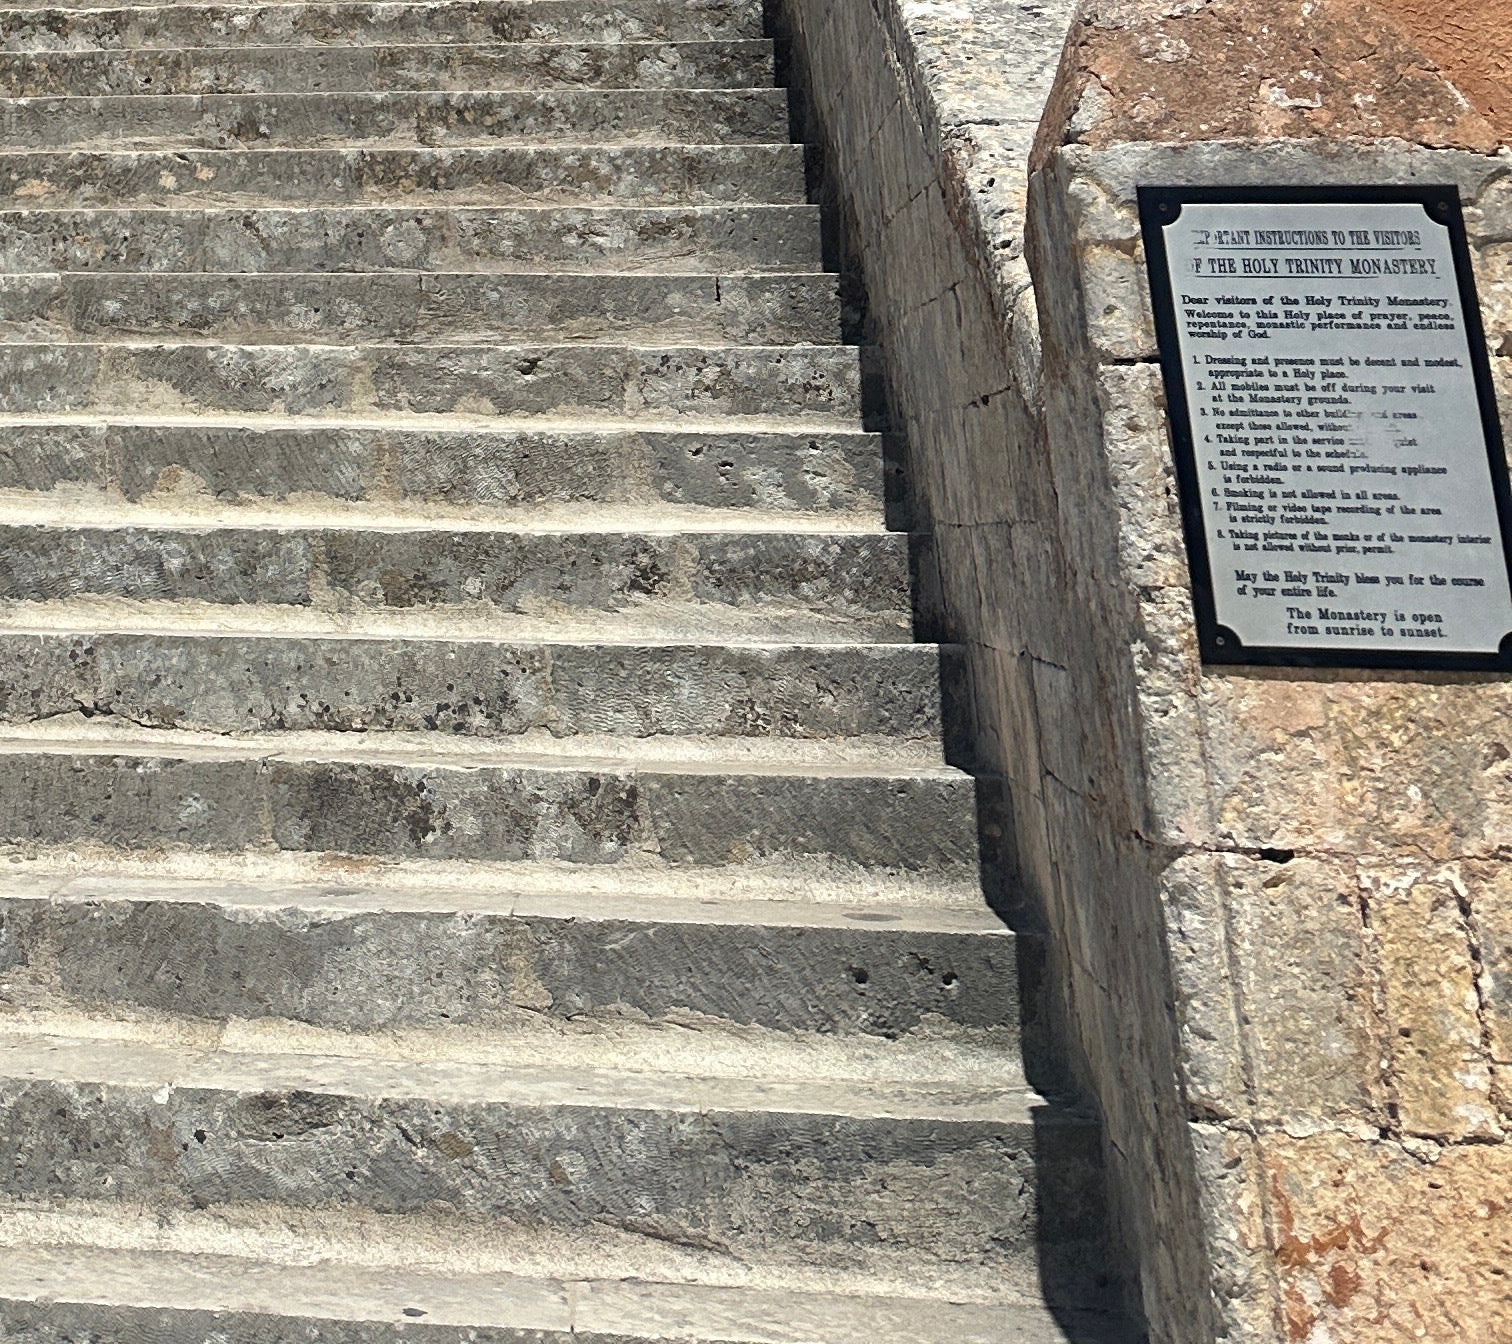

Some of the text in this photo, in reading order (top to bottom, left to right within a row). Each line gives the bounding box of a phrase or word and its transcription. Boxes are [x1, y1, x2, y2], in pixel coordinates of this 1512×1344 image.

[1254, 230, 1328, 245] INSTRUCTIONS
[1332, 231, 1345, 245] TO
[1349, 231, 1370, 245] THE
[1374, 231, 1421, 245] VISITORS
[1186, 258, 1436, 274] F THE HOLY TRINITY MONASTERY
[1181, 295, 1209, 305] Dear
[1215, 296, 1257, 305] visitors
[1263, 296, 1274, 305] of
[1280, 296, 1299, 305] the
[1305, 296, 1332, 307] Holy
[1338, 296, 1380, 307] Trinity
[1184, 310, 1233, 318] Welcome
[1239, 310, 1250, 318] to
[1256, 310, 1278, 318] this
[1283, 310, 1310, 321] Holy
[1316, 311, 1346, 321] place
[1352, 311, 1362, 320] of
[1255, 321, 1305, 329] monastic
[1311, 321, 1381, 331] performance
[1414, 321, 1454, 329] endless
[1188, 330, 1271, 340] worship of God.
[1193, 355, 1200, 365] 1.
[1205, 355, 1247, 367] Dressing
[1251, 356, 1270, 365] and
[1274, 357, 1315, 366] presence
[1320, 357, 1344, 365] must
[1349, 357, 1360, 366] be
[1365, 357, 1396, 366] decent
[1401, 357, 1420, 366] and
[1209, 369, 1264, 379] appropriate
[1268, 369, 1278, 377] to
[1293, 369, 1315, 380] Holy
[1197, 382, 1436, 395] 2. All mobiles must be off during your visit
[1228, 394, 1244, 402] the
[1249, 394, 1302, 405] Monastery
[1213, 408, 1225, 416] No
[1230, 408, 1279, 417] admittance
[1283, 409, 1292, 417] to
[1296, 409, 1319, 417] other
[1216, 422, 1244, 431] except
[1248, 422, 1272, 430] those
[1217, 435, 1249, 445] Taking
[1254, 436, 1274, 444] part
[1278, 436, 1288, 444] in
[1292, 436, 1307, 444] the
[1312, 436, 1345, 445] service
[1220, 448, 1236, 456] and
[1242, 448, 1288, 459] respectful
[1292, 449, 1302, 457] to
[1306, 449, 1321, 458] the
[1208, 462, 1216, 470] 5.
[1220, 462, 1248, 472] Using
[1264, 463, 1287, 471] radio
[1317, 463, 1345, 472] sound
[1350, 464, 1397, 475] producing
[1402, 465, 1447, 475] appliance
[1223, 475, 1232, 483] is
[1224, 488, 1264, 499] Smoking
[1269, 490, 1277, 498] is
[1282, 490, 1298, 498] not
[1301, 490, 1336, 499] allowed
[1341, 491, 1351, 499] in
[1356, 491, 1368, 499] all
[1226, 502, 1263, 513] Filming
[1282, 504, 1307, 512] video
[1312, 504, 1332, 514] tape
[1337, 504, 1381, 516] recording
[1386, 505, 1395, 514] of
[1400, 505, 1416, 514] the
[1421, 507, 1442, 515] area
[1229, 514, 1237, 522] is
[1242, 514, 1275, 525] strictly
[1217, 530, 1225, 538] 8.
[1229, 530, 1259, 541] Taking
[1263, 531, 1297, 541] pictures
[1301, 531, 1310, 539] of
[1314, 531, 1328, 540] the
[1333, 532, 1360, 541] monks
[1377, 533, 1386, 541] of
[1390, 534, 1404, 542] the
[1408, 535, 1452, 544] monastery
[1458, 534, 1491, 544] interior
[1263, 543, 1294, 551] allowed
[1298, 543, 1332, 552] without
[1235, 570, 1485, 586] May the Holy Trinity bless you for the course
[1237, 585, 1337, 598] of your entire life.
[1287, 608, 1443, 625] The Monastery is open
[1287, 623, 1447, 637] from sunrise to sunset.
